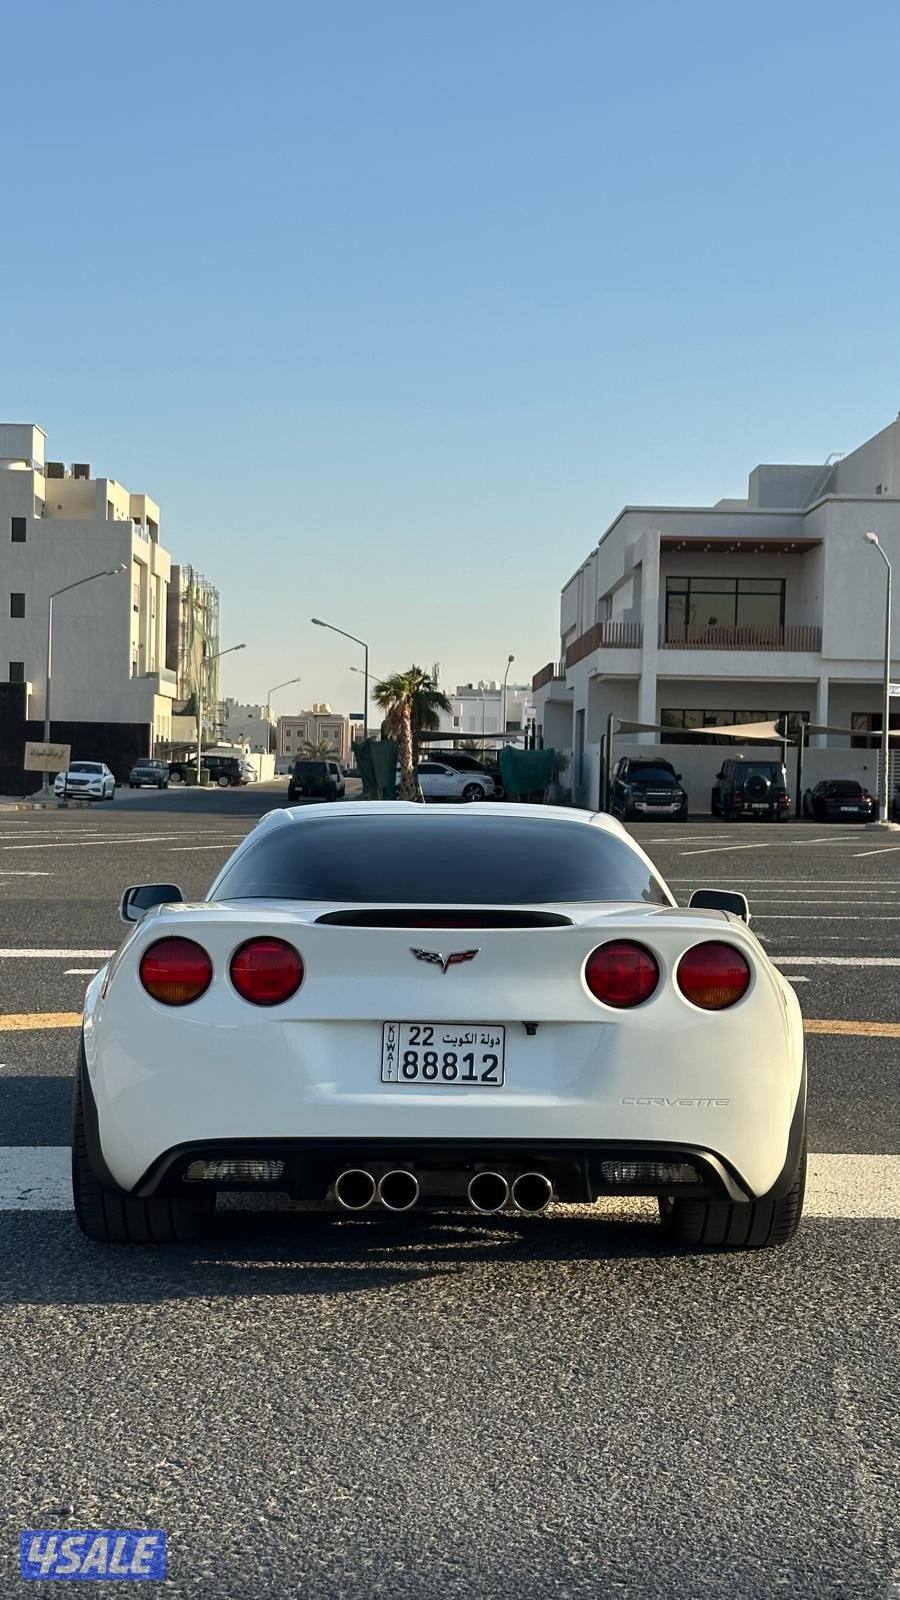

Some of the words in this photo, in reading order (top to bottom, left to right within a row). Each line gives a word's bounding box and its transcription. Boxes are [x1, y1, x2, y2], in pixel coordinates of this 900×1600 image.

[409, 1026, 435, 1046] 22
[442, 1032, 478, 1047] الكويت
[480, 1033, 501, 1048] دولة
[387, 1025, 396, 1080] KUWAIT
[402, 1050, 499, 1082] 88812
[620, 1097, 730, 1106] CORVETTE
